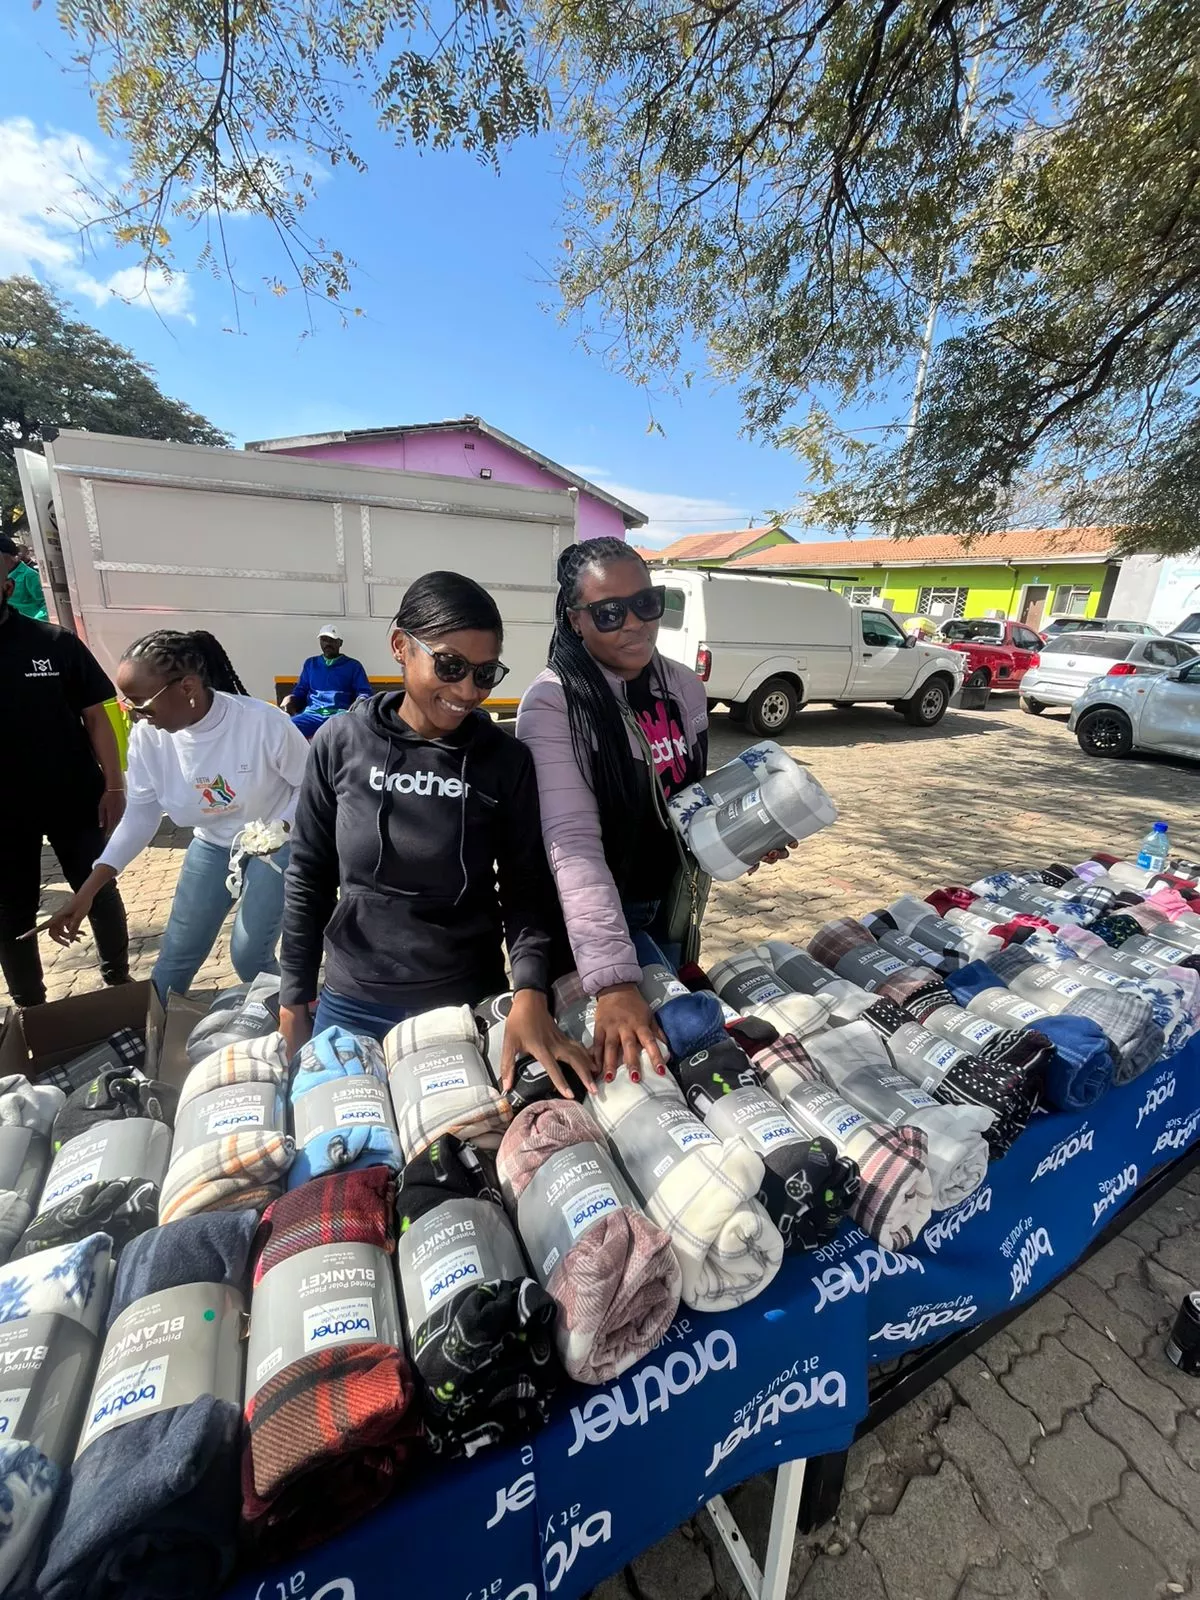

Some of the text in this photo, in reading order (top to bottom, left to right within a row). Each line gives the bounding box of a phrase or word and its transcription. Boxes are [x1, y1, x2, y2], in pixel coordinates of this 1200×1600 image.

[369, 766, 471, 799] brother
[413, 1054, 464, 1073] BLANKET
[332, 1088, 385, 1100] BLANKET
[426, 1079, 465, 1091] brother
[213, 1114, 260, 1128] brother
[340, 1112, 381, 1121] brother
[762, 1126, 795, 1142] brother
[1031, 1130, 1095, 1183] brother
[546, 1160, 599, 1203] BLANKET
[573, 1197, 617, 1228] brother
[1024, 1216, 1033, 1230] at
[411, 1220, 475, 1266] BLANKET
[812, 1239, 844, 1262] side
[1010, 1227, 1054, 1301] brother
[298, 1268, 375, 1293] BLANKET
[300, 1286, 327, 1298] Fleece
[351, 1280, 375, 1289] Printed
[429, 1264, 478, 1300] brother
[907, 1295, 973, 1318] at your side
[311, 1318, 370, 1340] brother
[672, 1319, 693, 1340] at
[869, 1305, 978, 1341] brother
[146, 1332, 182, 1349] Printed
[3, 1360, 42, 1375] Printed
[568, 1329, 738, 1456] brother
[733, 1355, 820, 1424] at your side
[90, 1384, 156, 1429] brother
[705, 1370, 847, 1477] brother
